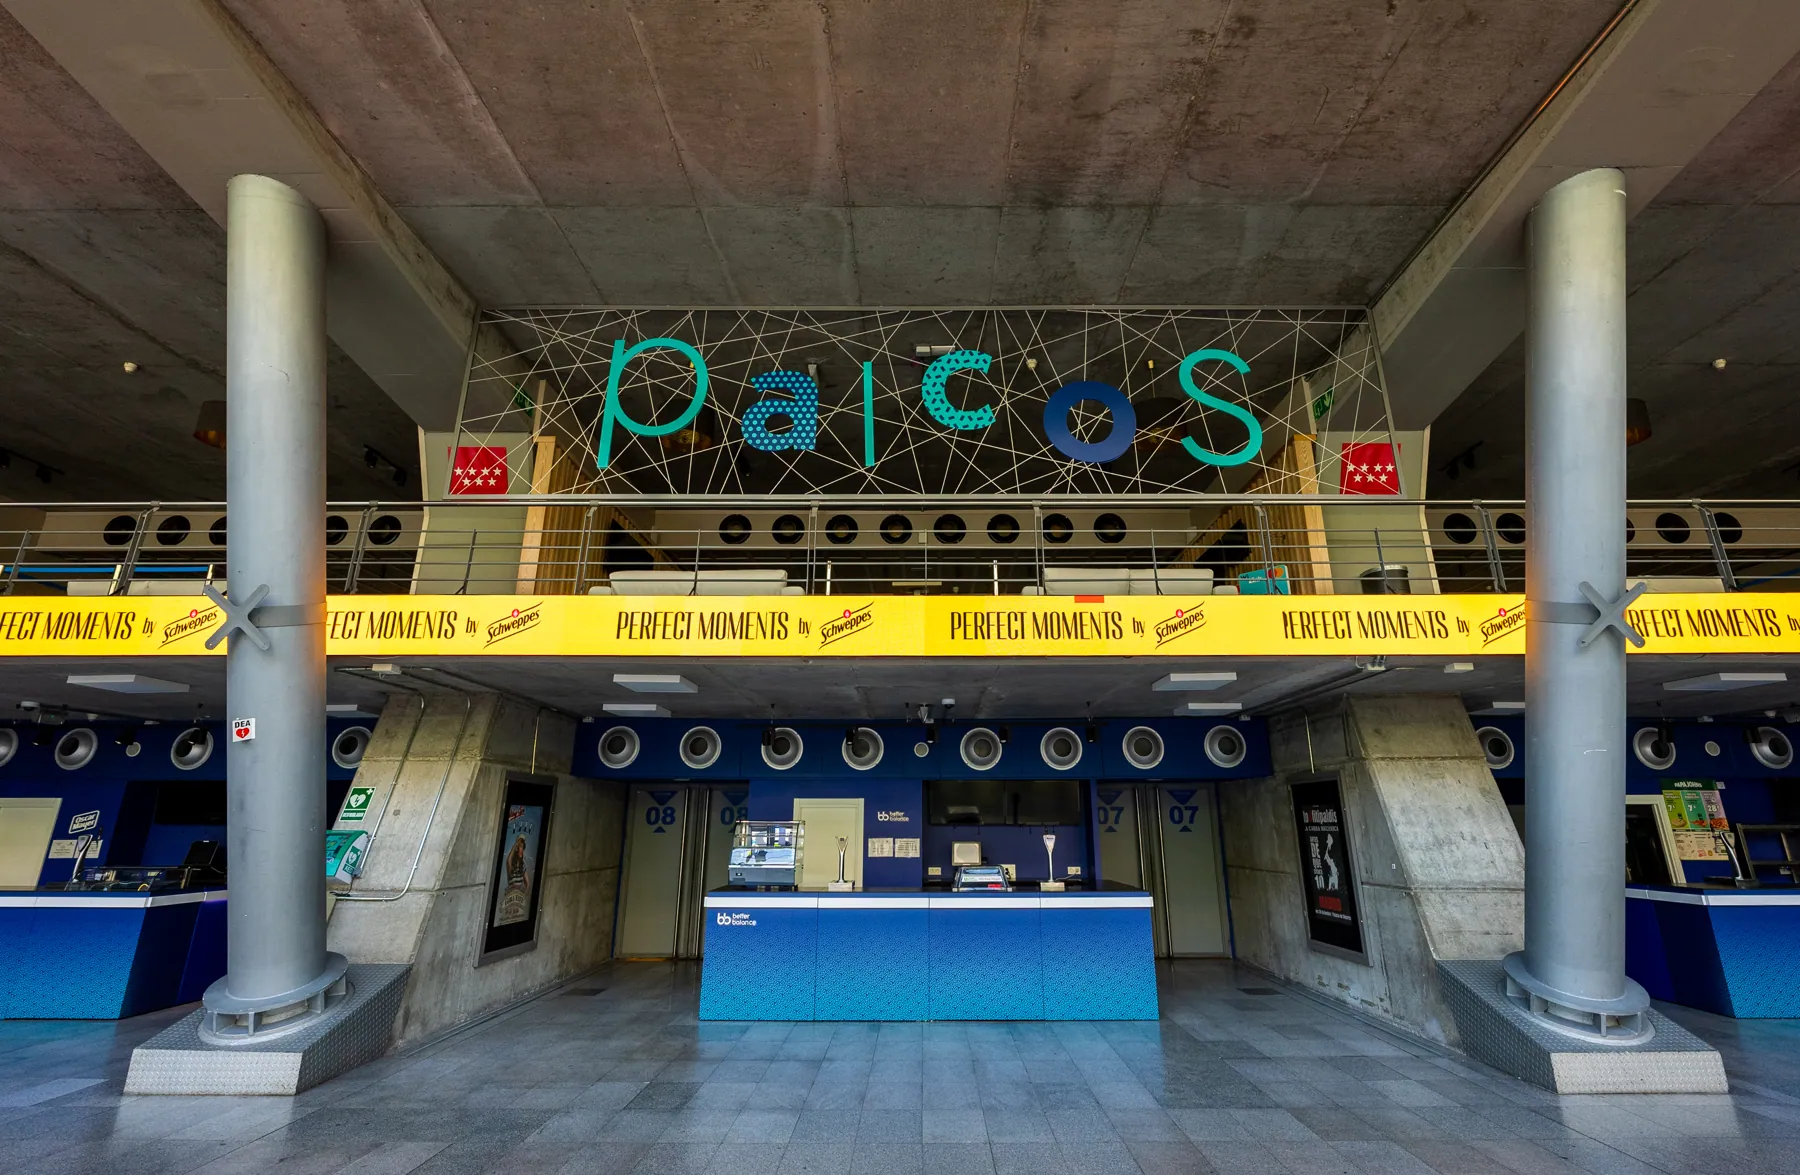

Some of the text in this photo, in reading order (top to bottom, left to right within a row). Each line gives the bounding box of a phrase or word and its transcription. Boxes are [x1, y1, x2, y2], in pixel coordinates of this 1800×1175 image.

[41, 611, 136, 640] MOMENTS
[142, 616, 157, 638] by
[161, 609, 219, 644] Schweppes
[365, 610, 458, 640] MOMENTS
[465, 616, 479, 638] by
[486, 609, 541, 644] Schweppes
[615, 610, 872, 645] PERFECT MOMENTS by Schweppes
[950, 609, 1205, 644] PERFECT MOMENTS by Schweppes
[1356, 610, 1449, 640] MOMENTS
[1456, 616, 1470, 637] by
[1685, 608, 1782, 638] MOMENTS
[234, 719, 251, 729] DEA
[75, 813, 97, 824] Oscar
[645, 806, 676, 826] 08
[1169, 805, 1199, 825] 07
